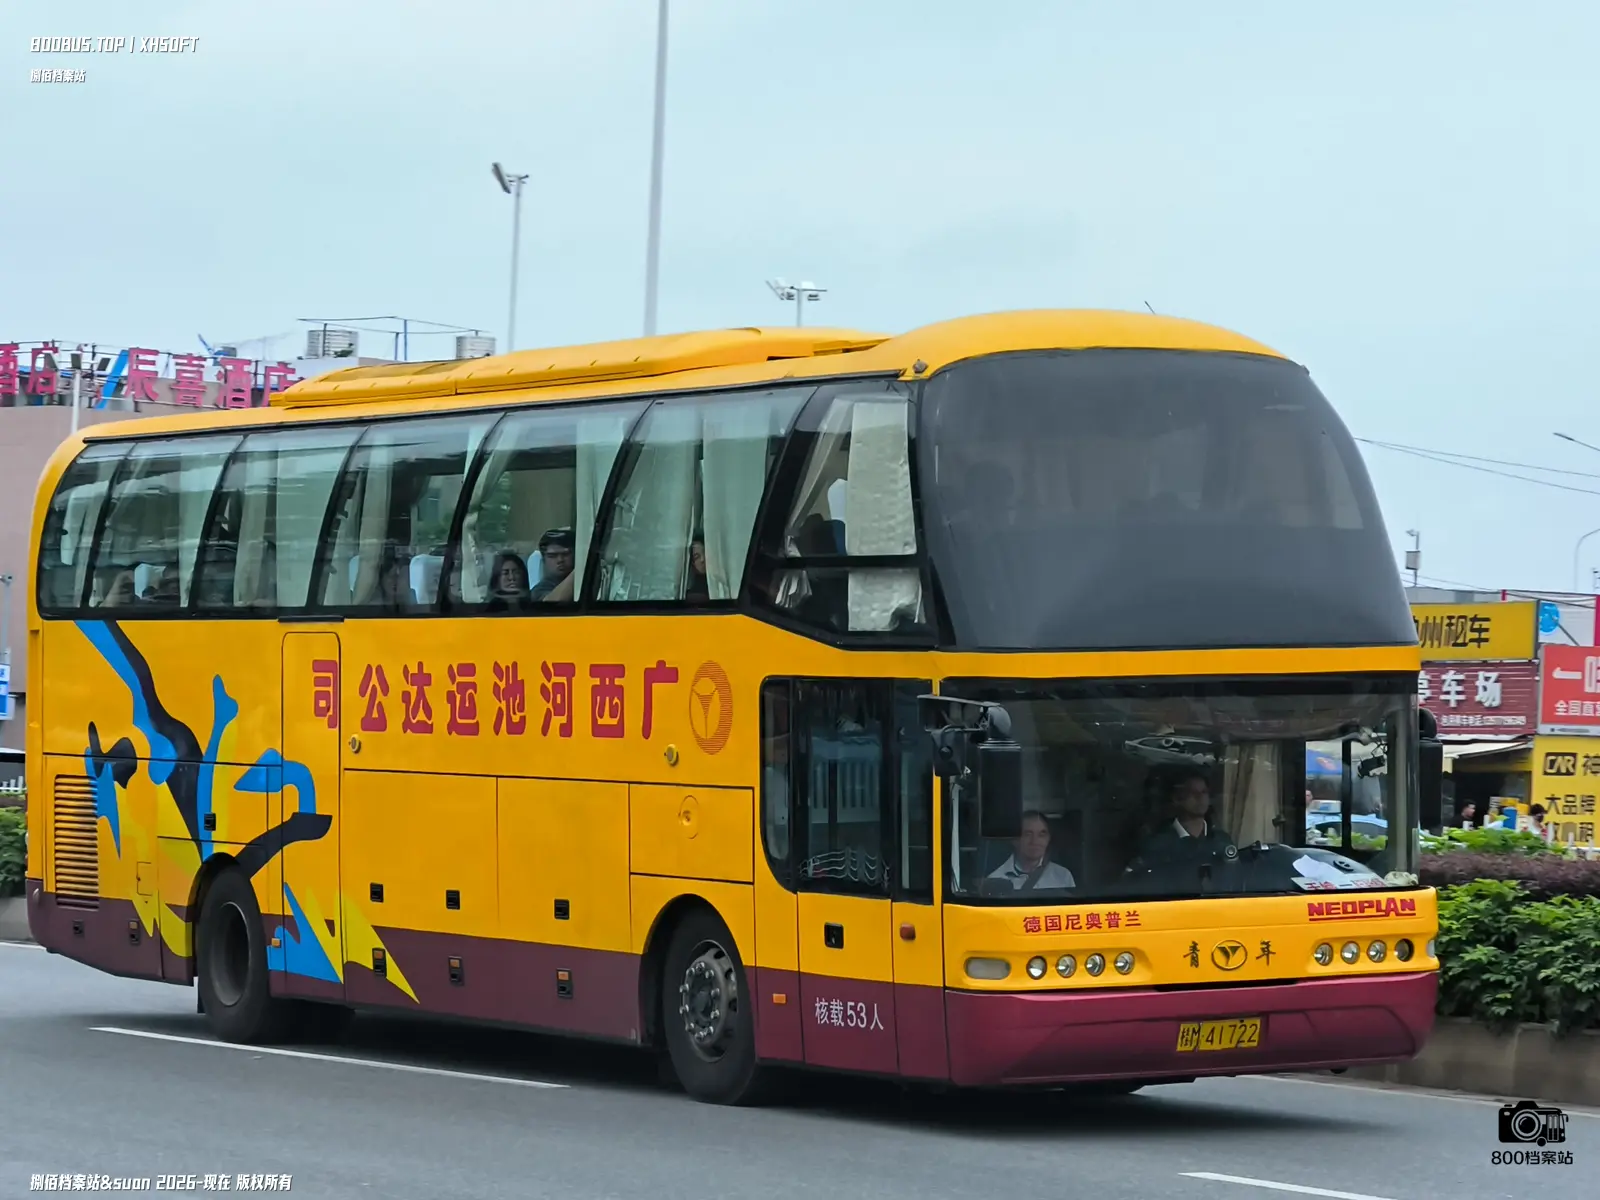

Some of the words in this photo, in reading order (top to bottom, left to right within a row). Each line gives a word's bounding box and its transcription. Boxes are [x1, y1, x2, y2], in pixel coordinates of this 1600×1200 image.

[1412, 614, 1491, 648] 州租车
[1023, 910, 1141, 933] 德国尼奥普兰
[1307, 897, 1417, 921] NEOPLAN
[815, 997, 884, 1030] 核载53人
